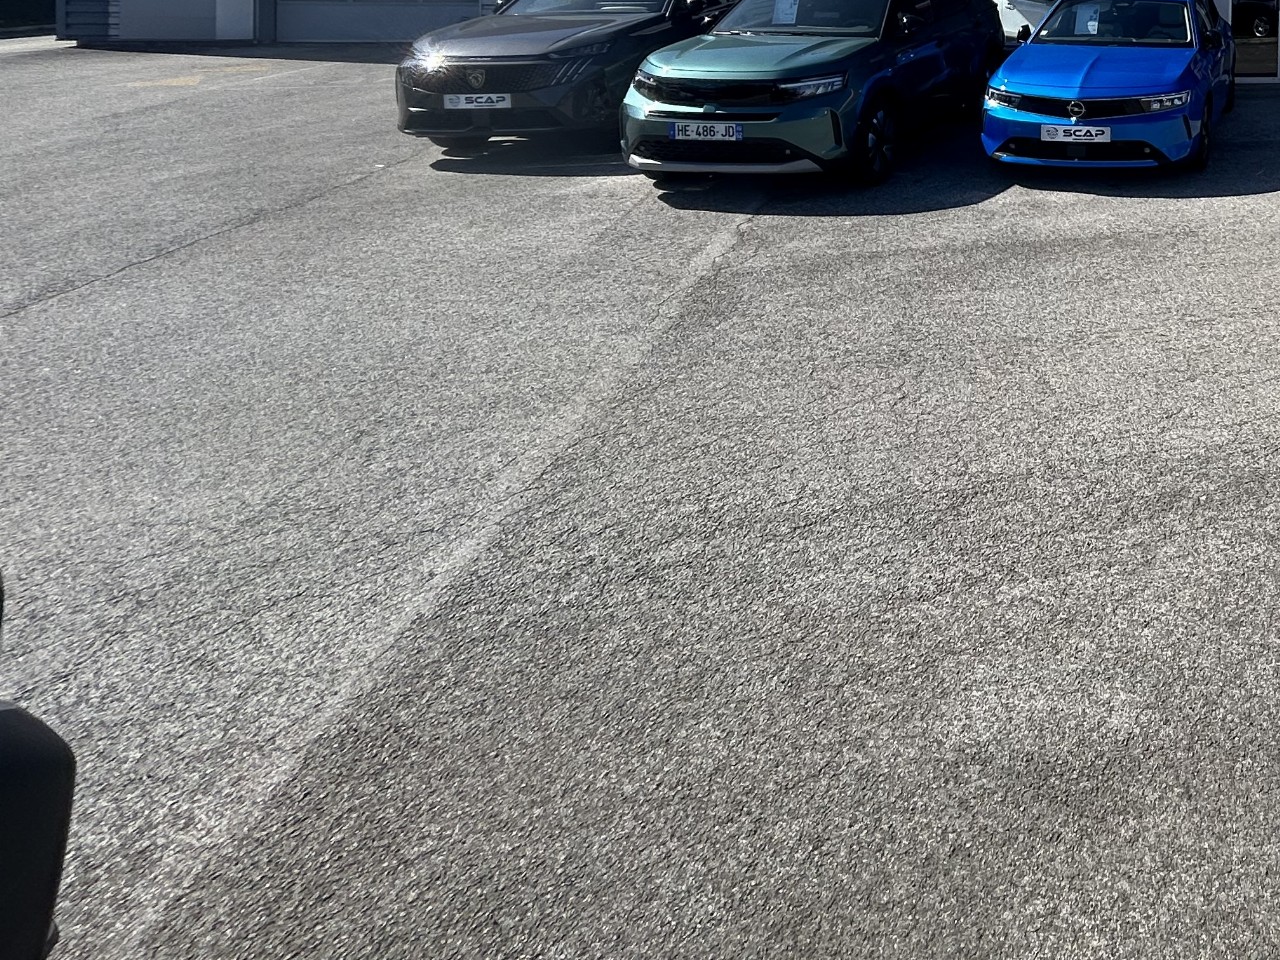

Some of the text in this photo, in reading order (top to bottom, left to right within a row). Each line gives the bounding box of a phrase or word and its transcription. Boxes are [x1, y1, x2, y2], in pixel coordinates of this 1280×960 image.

[464, 96, 506, 105] SCAP
[677, 124, 735, 138] HE-486-JD
[1062, 129, 1106, 138] SCAP
